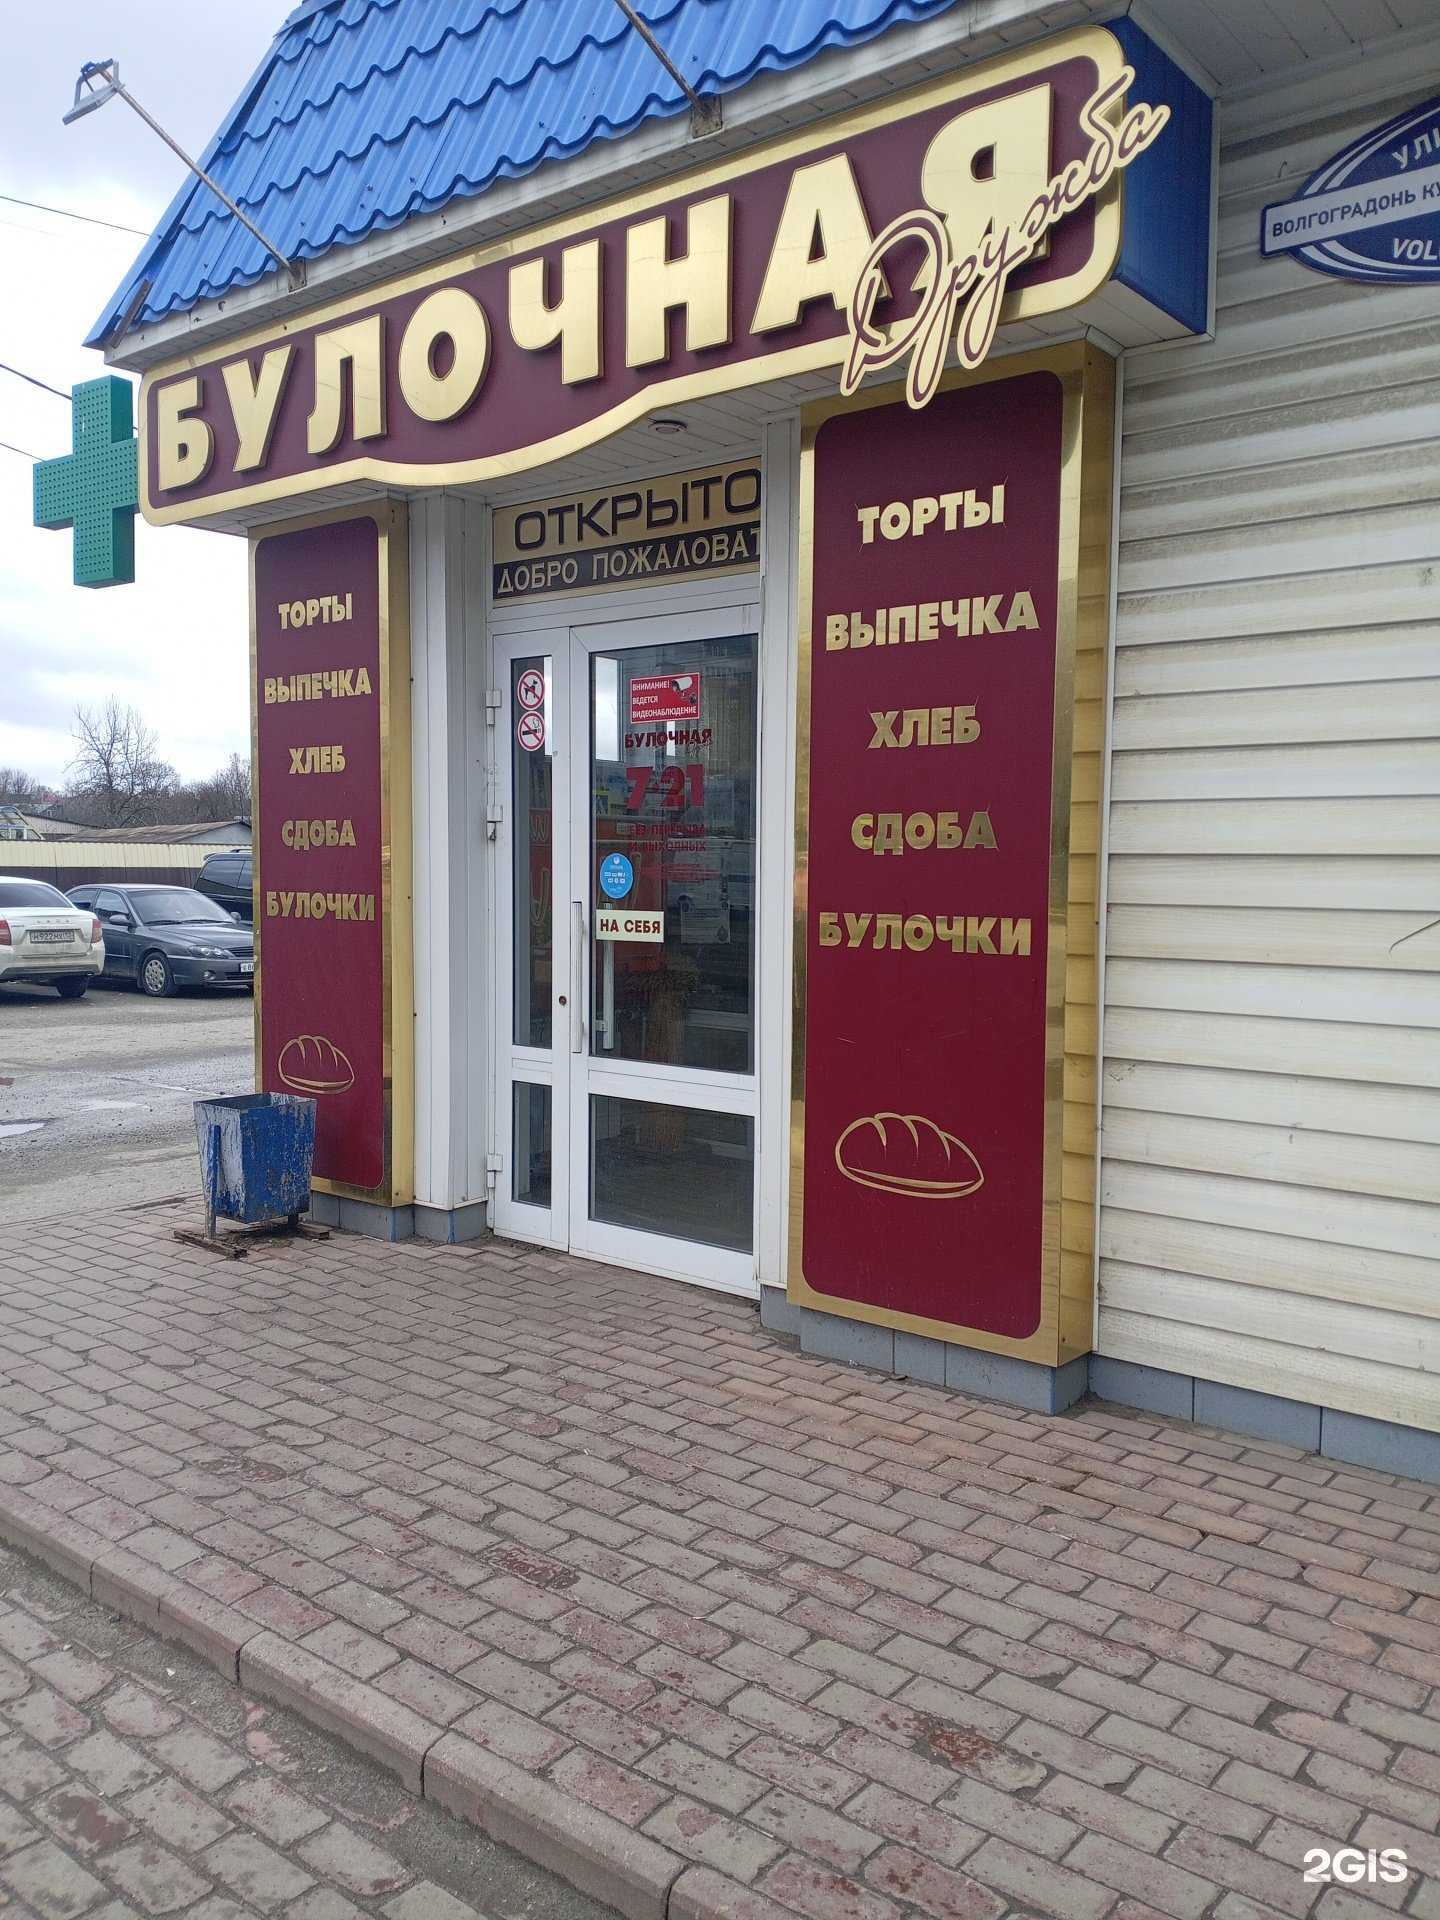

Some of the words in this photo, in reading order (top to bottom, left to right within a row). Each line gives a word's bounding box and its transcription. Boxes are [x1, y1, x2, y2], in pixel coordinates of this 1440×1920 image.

[1272, 189, 1417, 238] ВОЛГОГРАДОНЬ
[841, 66, 1170, 409] Дружба
[1392, 237, 1440, 262] VOL
[157, 83, 1054, 492] БУЛОЧНАЯ
[514, 468, 761, 551] ОТКРЫТО
[856, 483, 1006, 545] ТОРТЫ
[497, 557, 578, 594] ДОБРО
[278, 593, 353, 629] ТОРТЫ
[825, 591, 1039, 651] ВЫПЕЧКА
[264, 667, 372, 704] ВЫПЕЧКА
[632, 680, 671, 692] ВНИМАНИЕ!
[632, 695, 659, 706] ВЕДЕТСЯ
[632, 705, 697, 719] ВИДЕОНАБЛЮДЕНИЕ
[868, 706, 981, 748] ХЛЕБ
[624, 728, 713, 749] БУЛОЧНАЯ
[289, 745, 346, 775] ХЛЕБ
[281, 819, 357, 851] СДОБА
[851, 810, 998, 856] СДОБА
[266, 891, 376, 922] БУЛОЧКИ
[600, 919, 619, 932] НА
[624, 920, 661, 934] СЕБЯ
[818, 912, 1032, 956] БУЛОЧКИ
